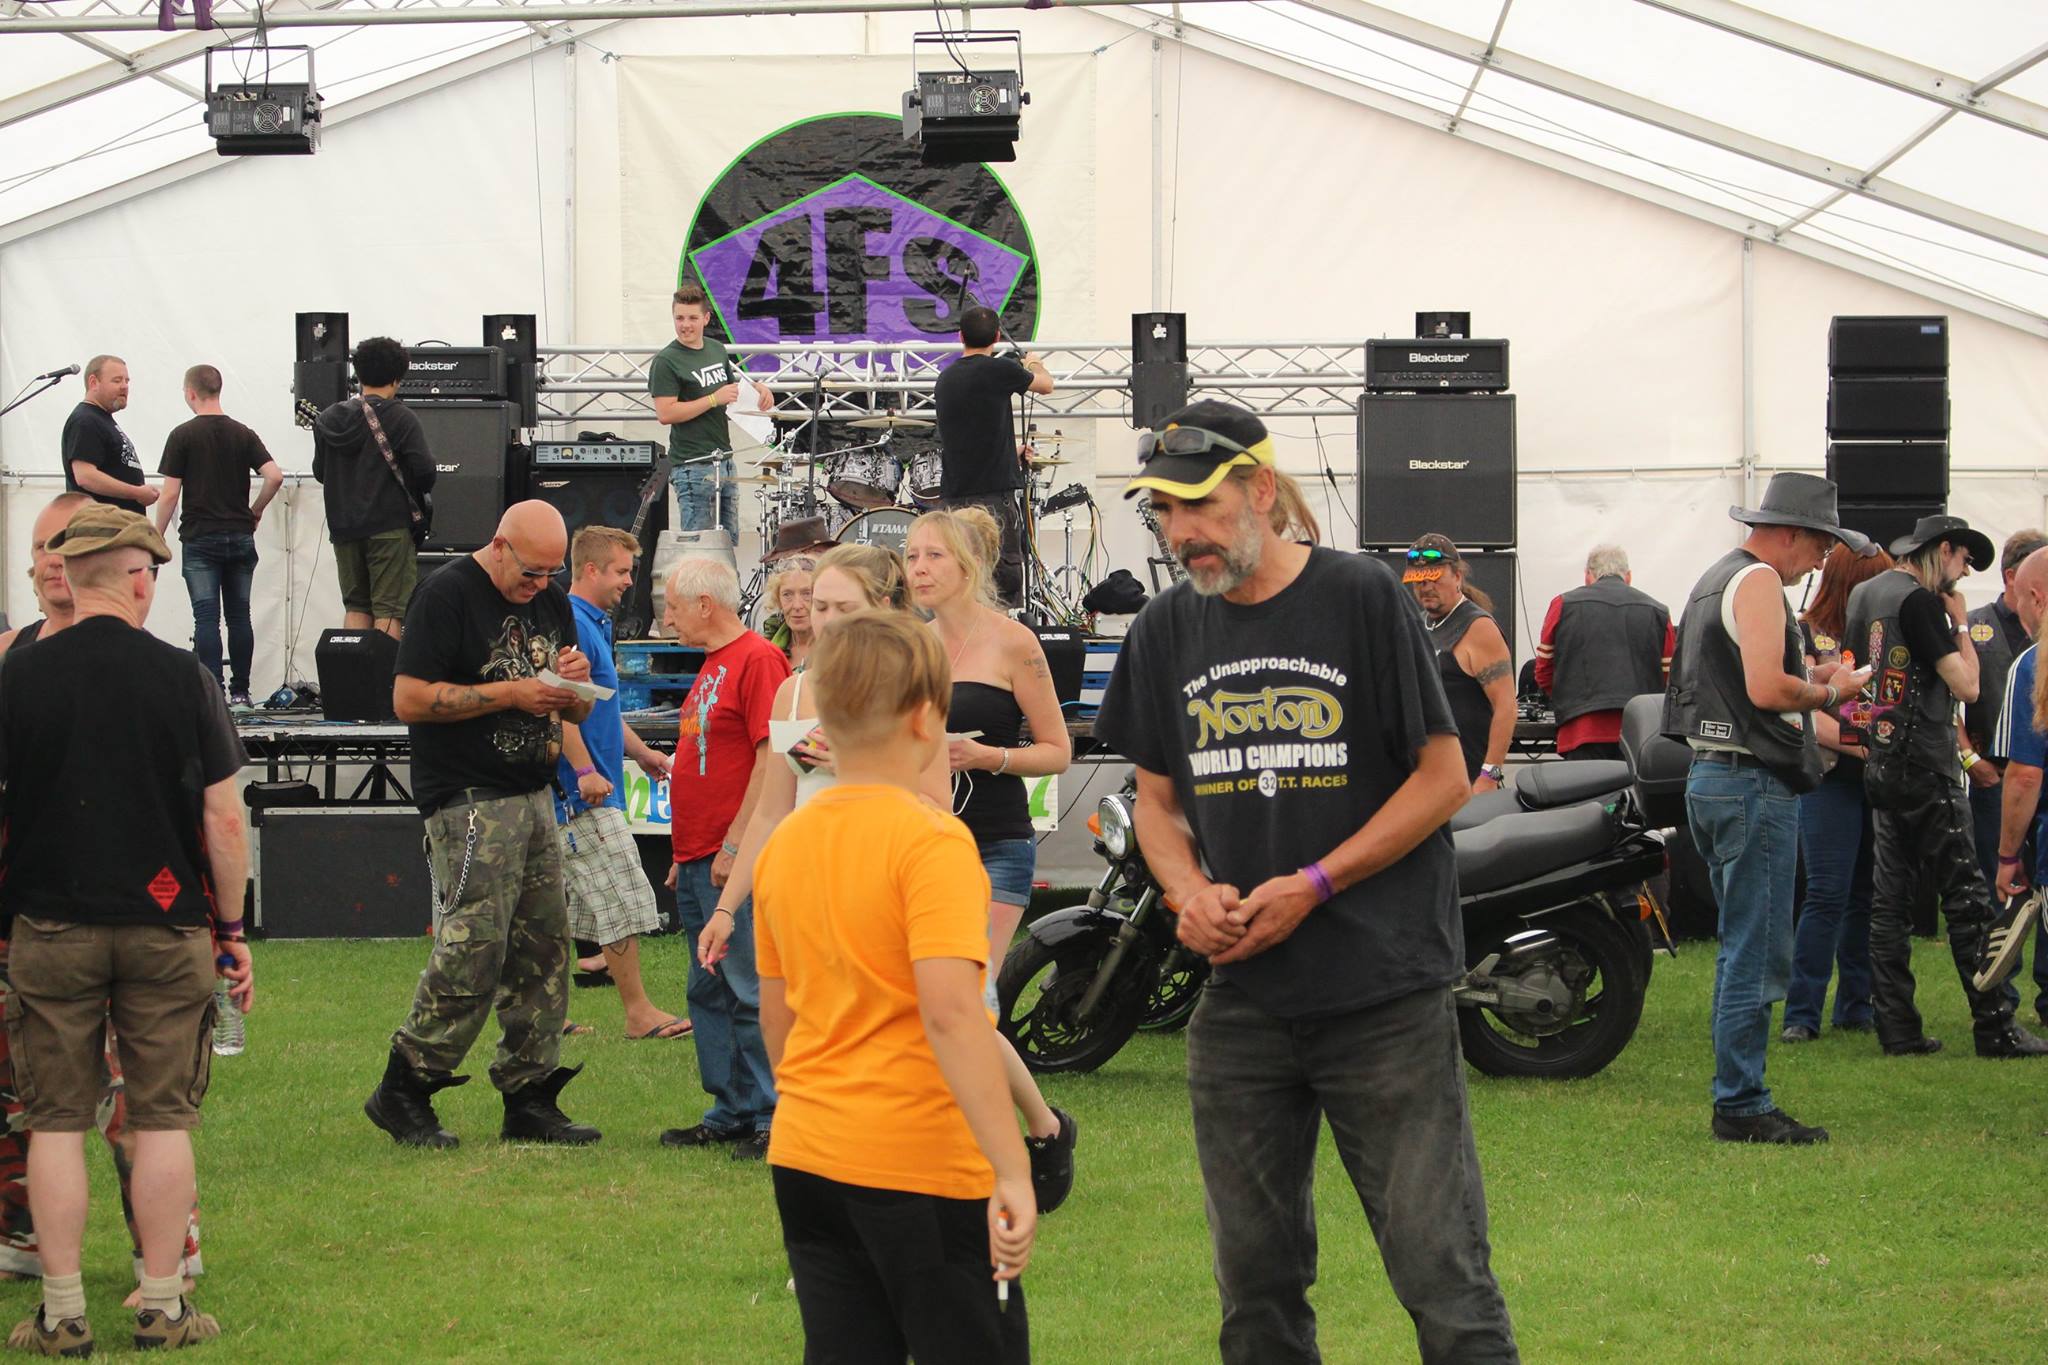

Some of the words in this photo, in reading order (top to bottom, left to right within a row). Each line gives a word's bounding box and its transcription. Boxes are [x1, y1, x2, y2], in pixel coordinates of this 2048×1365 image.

[737, 206, 980, 336] 4FS
[408, 361, 458, 371] lackstar
[1409, 353, 1469, 363] Blackstar
[691, 363, 728, 388] VANS
[1409, 460, 1469, 470] Blackstar
[879, 524, 908, 534] TAMA
[1183, 675, 1208, 698] The
[1209, 657, 1347, 687] Unapproachable
[1187, 686, 1344, 748] Norton
[1188, 748, 1242, 776] WORLD
[1246, 742, 1348, 770] CHAMPIONS
[1237, 779, 1257, 791] OF
[1262, 775, 1276, 790] 32
[1302, 774, 1348, 788] RACES
